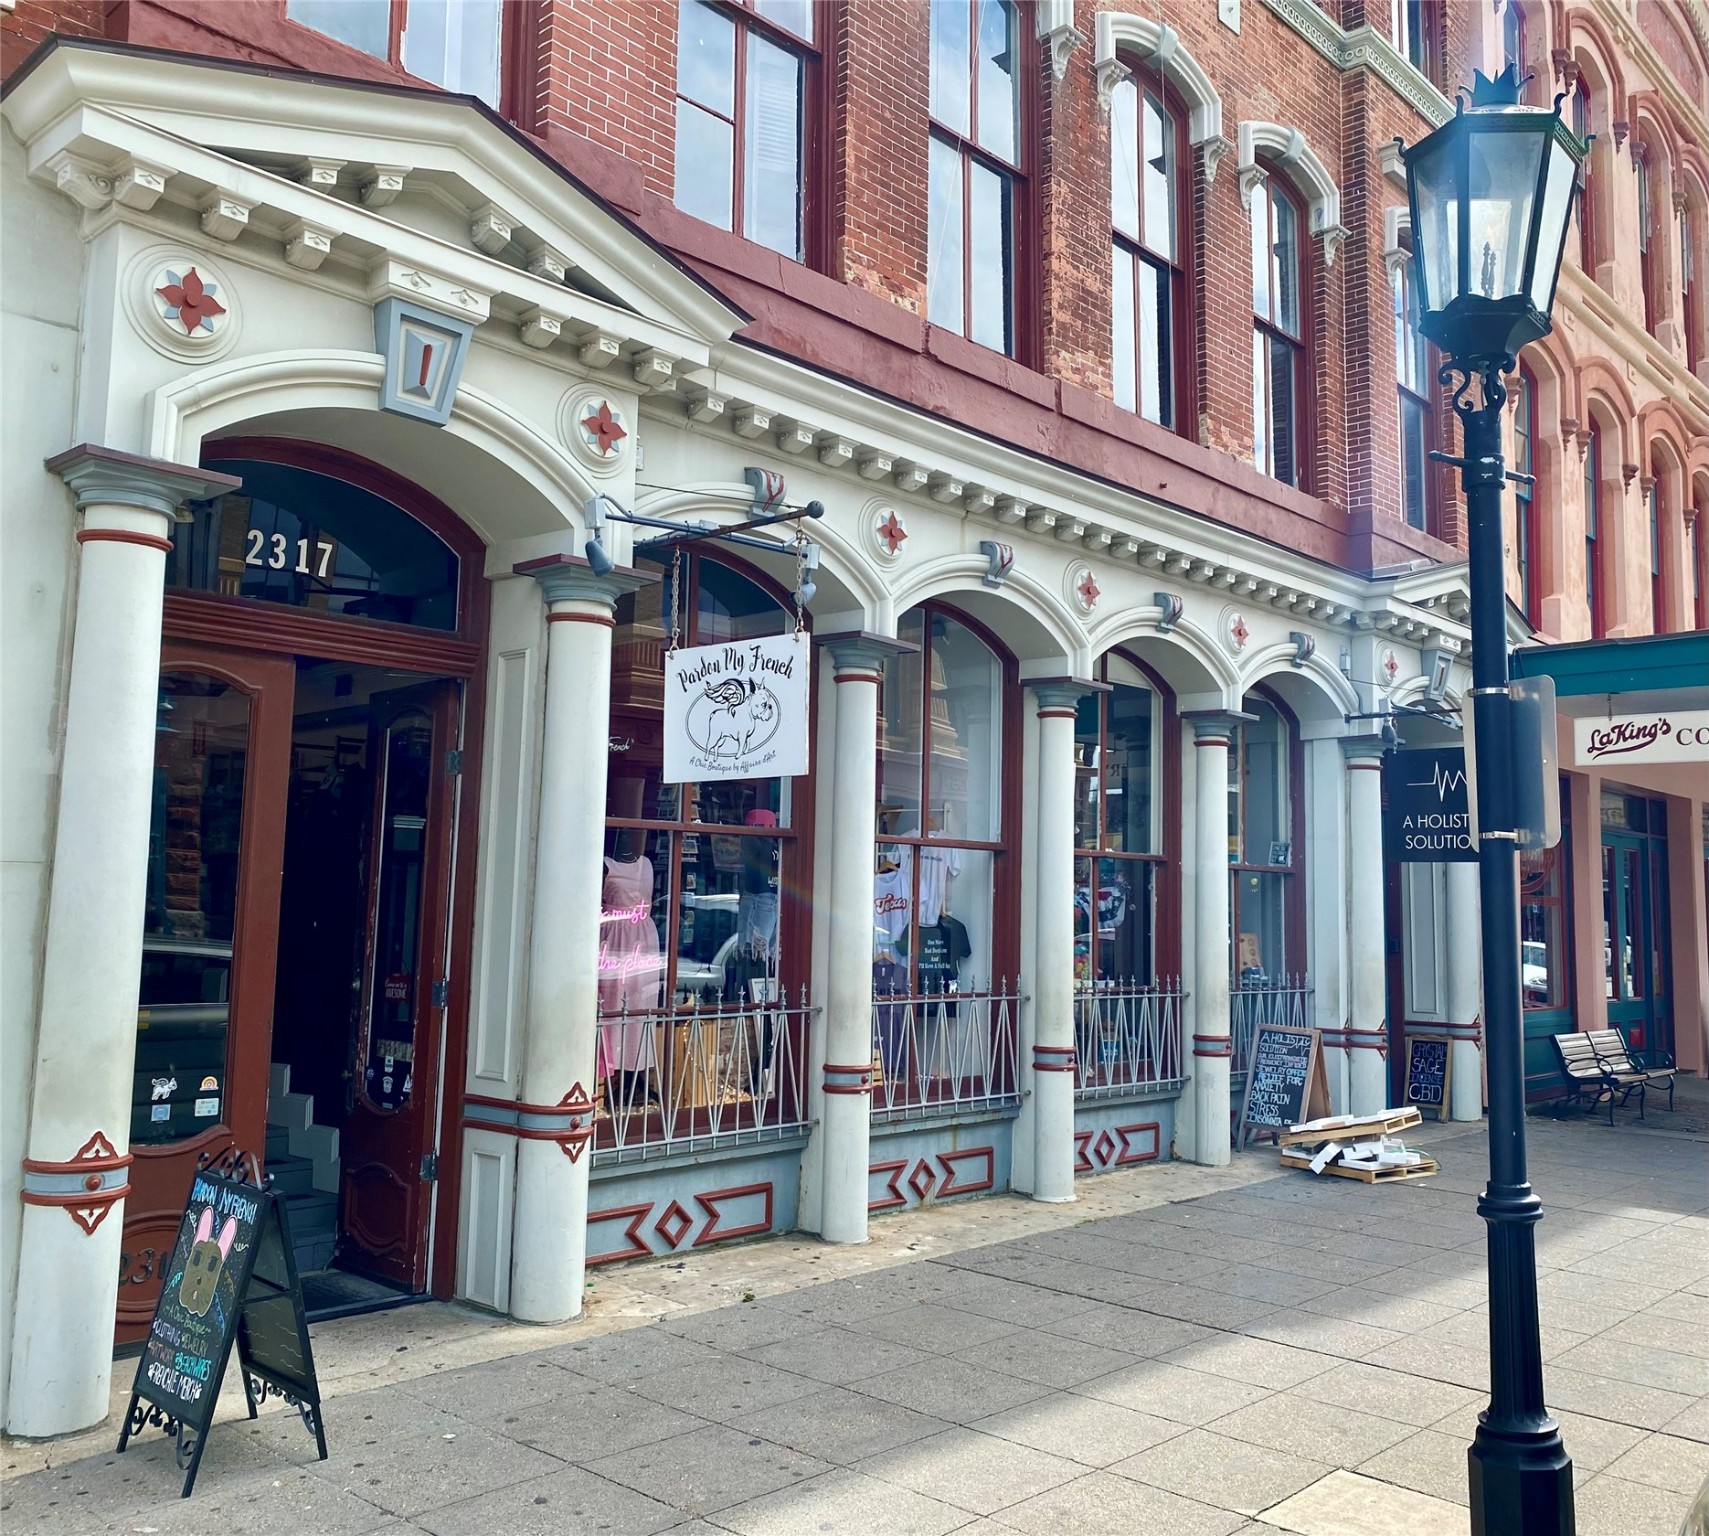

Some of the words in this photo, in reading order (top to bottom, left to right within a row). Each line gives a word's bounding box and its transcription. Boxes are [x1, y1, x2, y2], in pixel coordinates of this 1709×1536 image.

[246, 529, 333, 577] 2317
[676, 656, 721, 693] Pardon
[722, 647, 744, 676] My
[749, 645, 794, 679] French
[1587, 717, 1672, 760] LaKing's
[689, 756, 694, 765] A
[695, 758, 707, 769] Chic
[707, 761, 732, 775] Boutique
[732, 763, 740, 774] by
[1403, 815, 1414, 829] A
[1417, 813, 1469, 829] HOLIST
[1405, 834, 1472, 849] SOLUTIO
[612, 899, 650, 924] must
[1260, 1031, 1270, 1043] A
[1271, 1033, 1311, 1047] HOLISTIC
[1259, 1042, 1288, 1055] SOLUTION
[1256, 1064, 1286, 1075] JEWELRY
[1411, 1057, 1444, 1075] SAGE
[1258, 1072, 1285, 1084] RELIEF
[1252, 1080, 1285, 1093] ANXIETY
[1408, 1083, 1442, 1102] CBD
[1250, 1090, 1269, 1103] BACK
[1270, 1092, 1291, 1105] PAIN
[1248, 1100, 1279, 1117] STRESS
